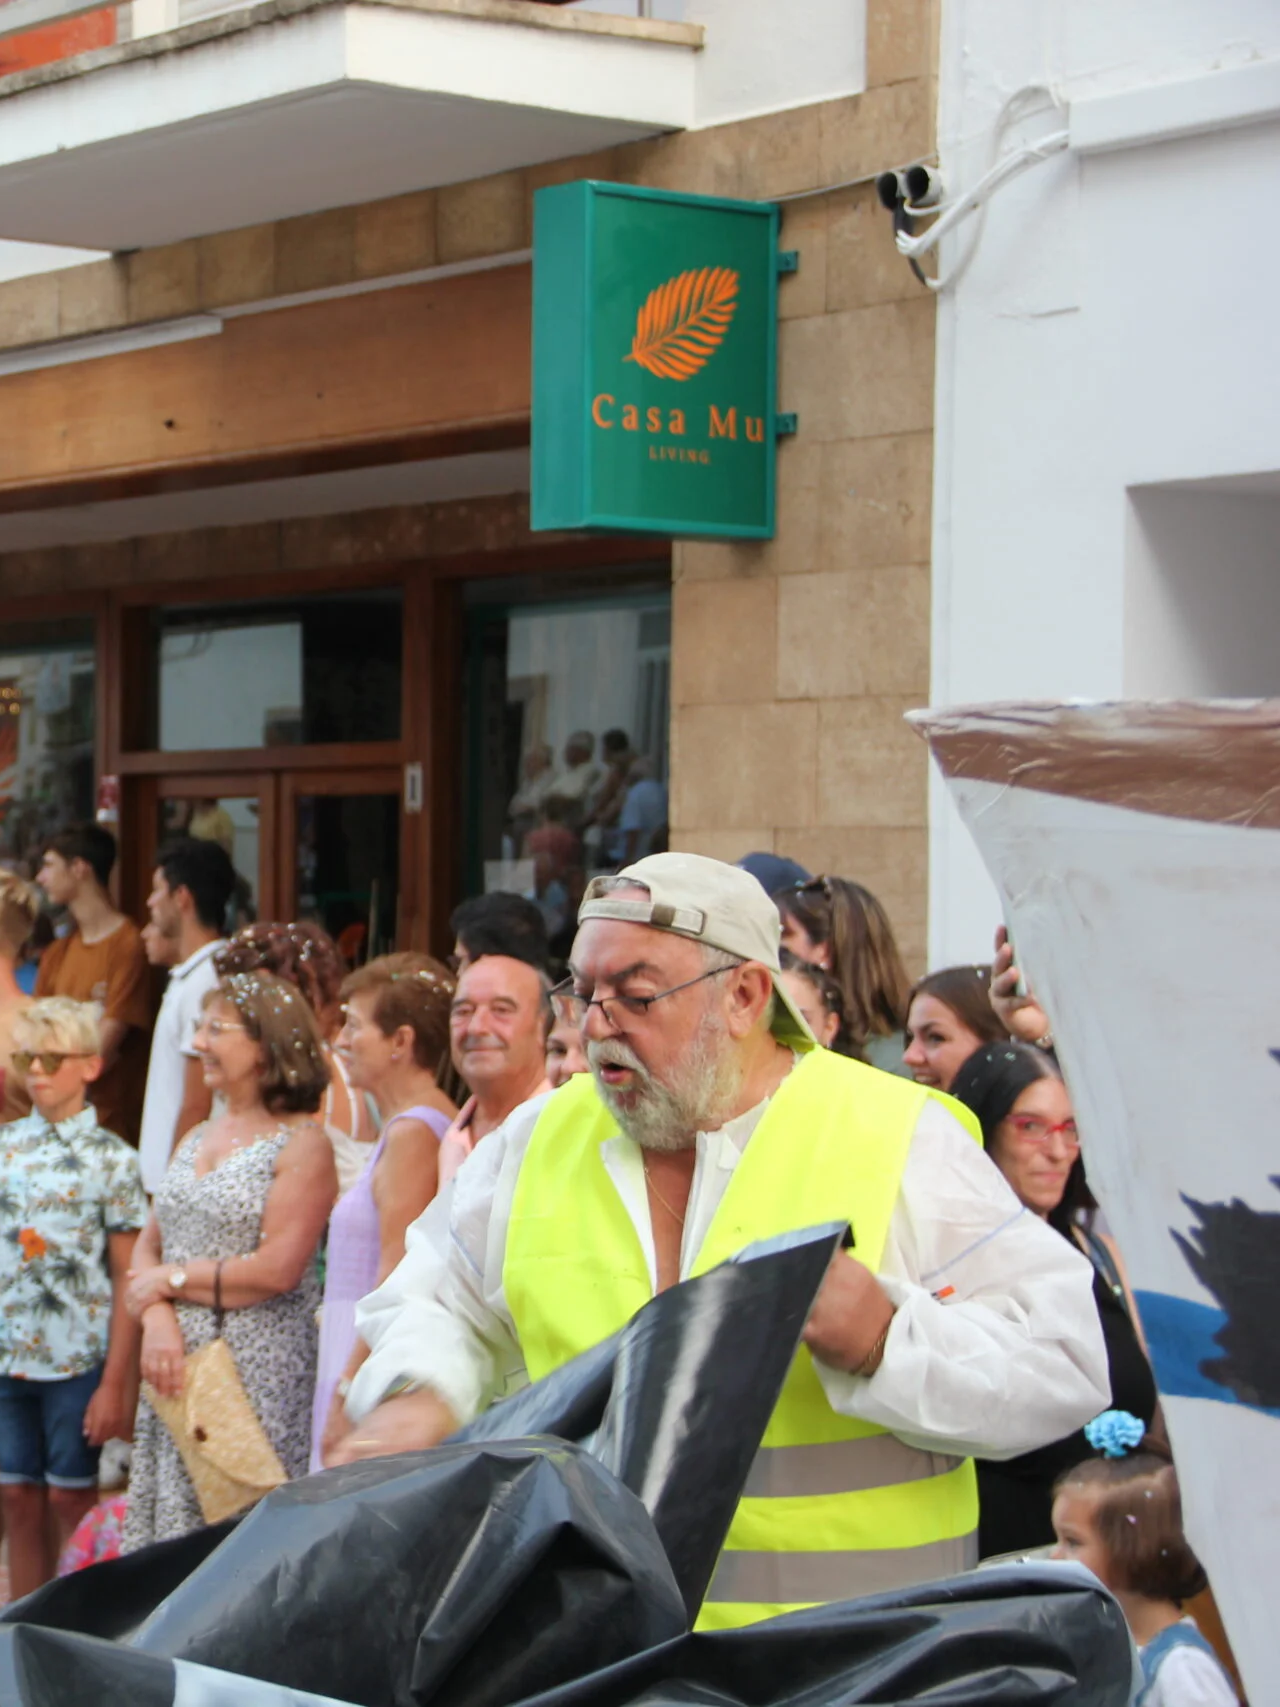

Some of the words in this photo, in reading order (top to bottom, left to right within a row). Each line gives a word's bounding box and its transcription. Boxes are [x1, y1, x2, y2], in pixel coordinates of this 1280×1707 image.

[591, 392, 687, 435] Casa
[707, 404, 765, 442] Mu
[648, 445, 710, 464] LIVING
